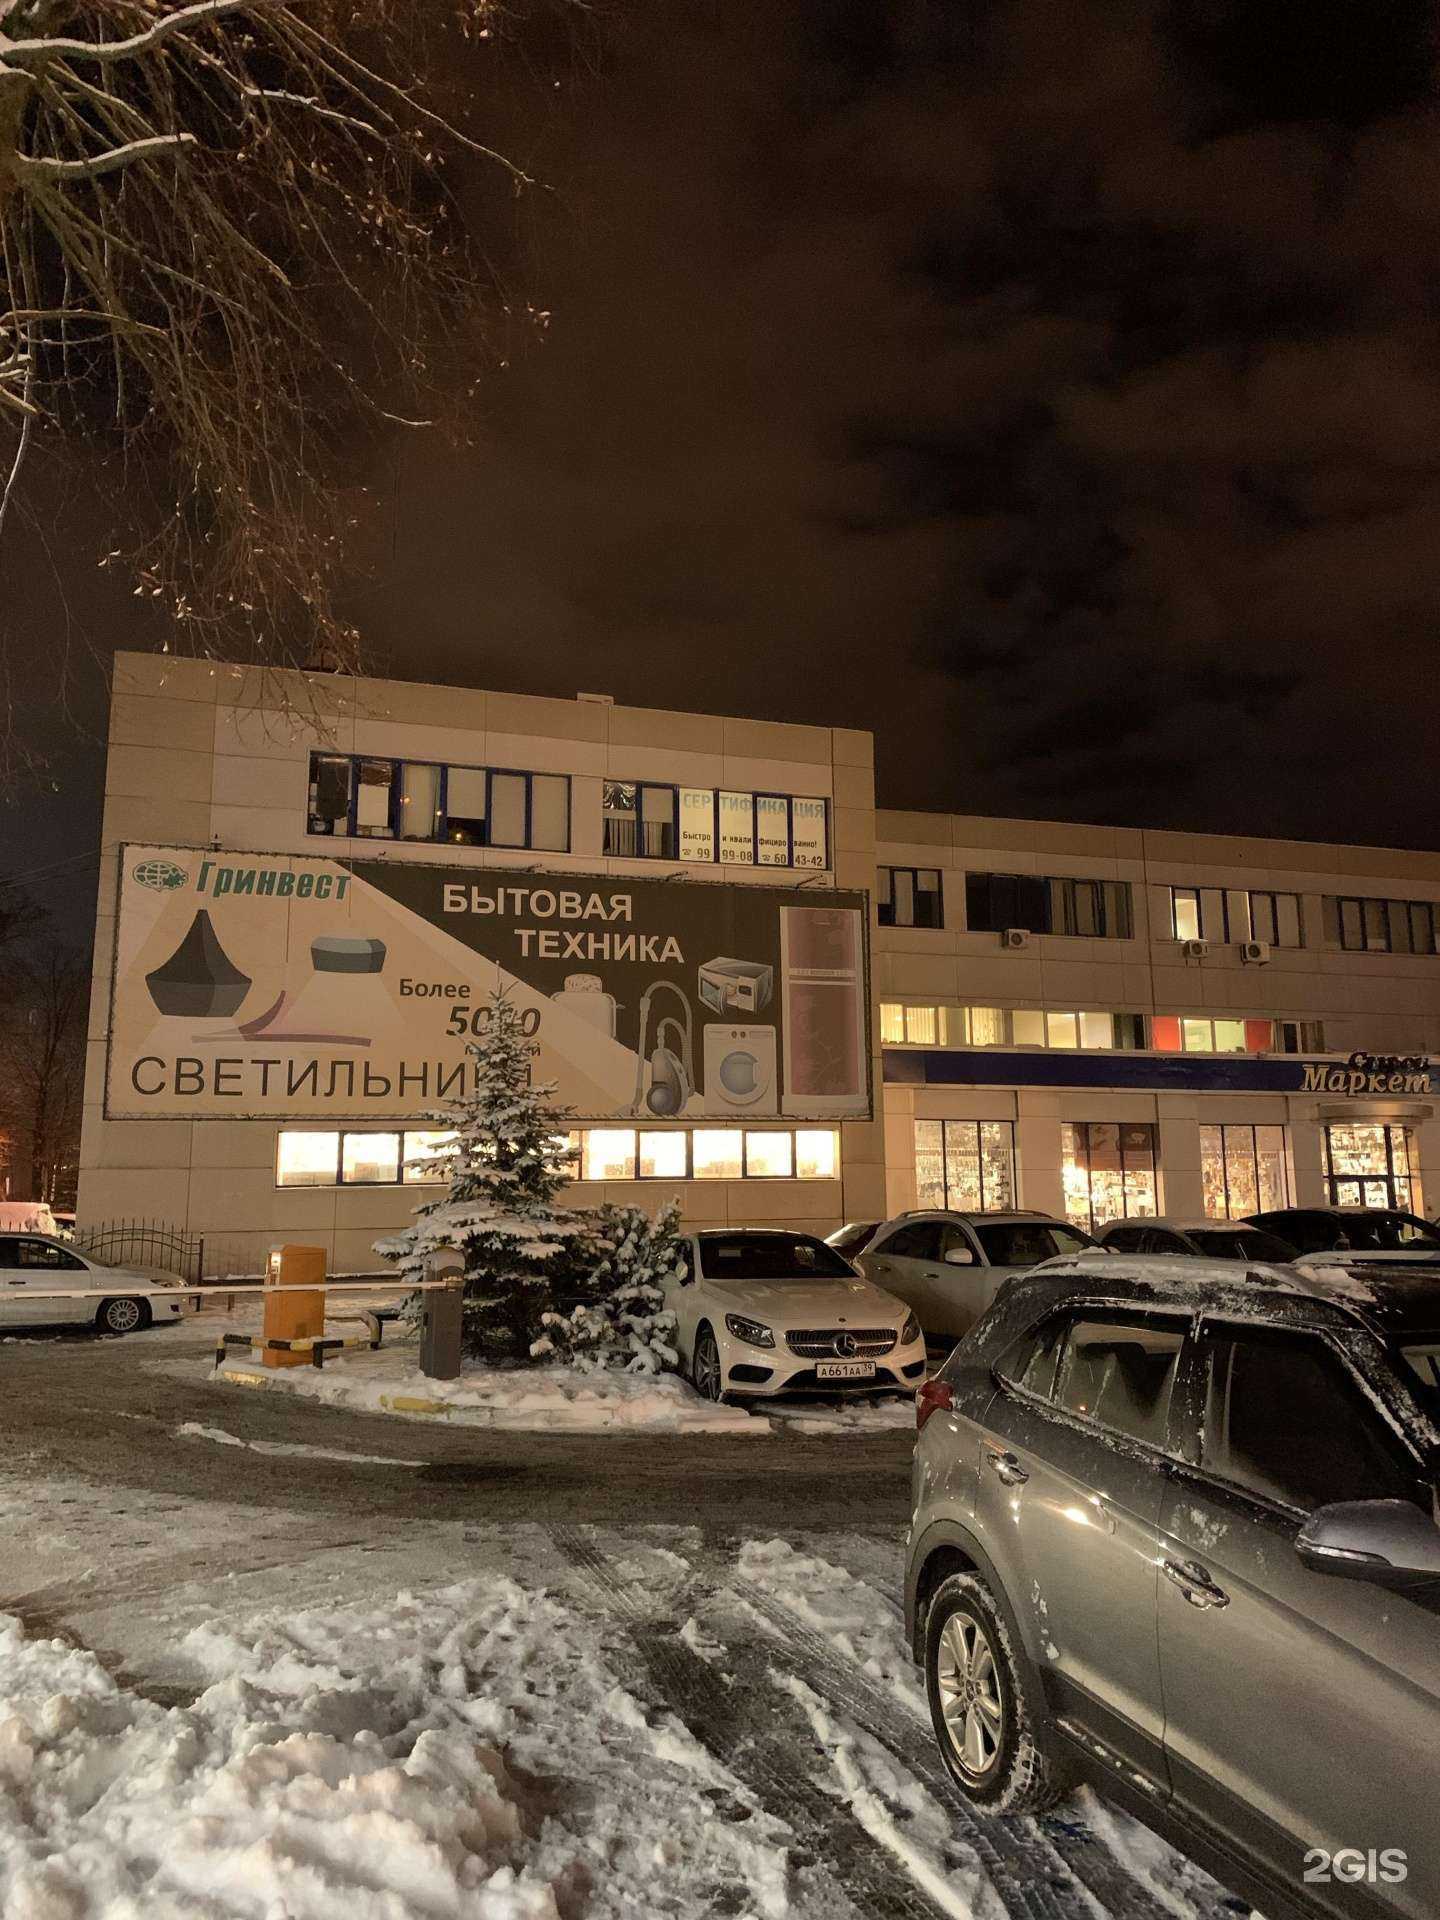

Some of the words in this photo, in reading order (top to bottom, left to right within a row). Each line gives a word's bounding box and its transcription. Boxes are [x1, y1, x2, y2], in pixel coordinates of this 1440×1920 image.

[682, 831, 711, 841] Быстро
[697, 847, 710, 858] 99
[774, 854, 787, 864] 60
[795, 855, 823, 867] 43-42
[196, 861, 352, 900] Гринвест
[443, 884, 632, 922] БЫТОВАЯ
[514, 929, 685, 964] ТЕХНИКА
[400, 979, 471, 998] Более
[446, 1006, 541, 1038] 500
[1301, 1064, 1433, 1098] Маркет
